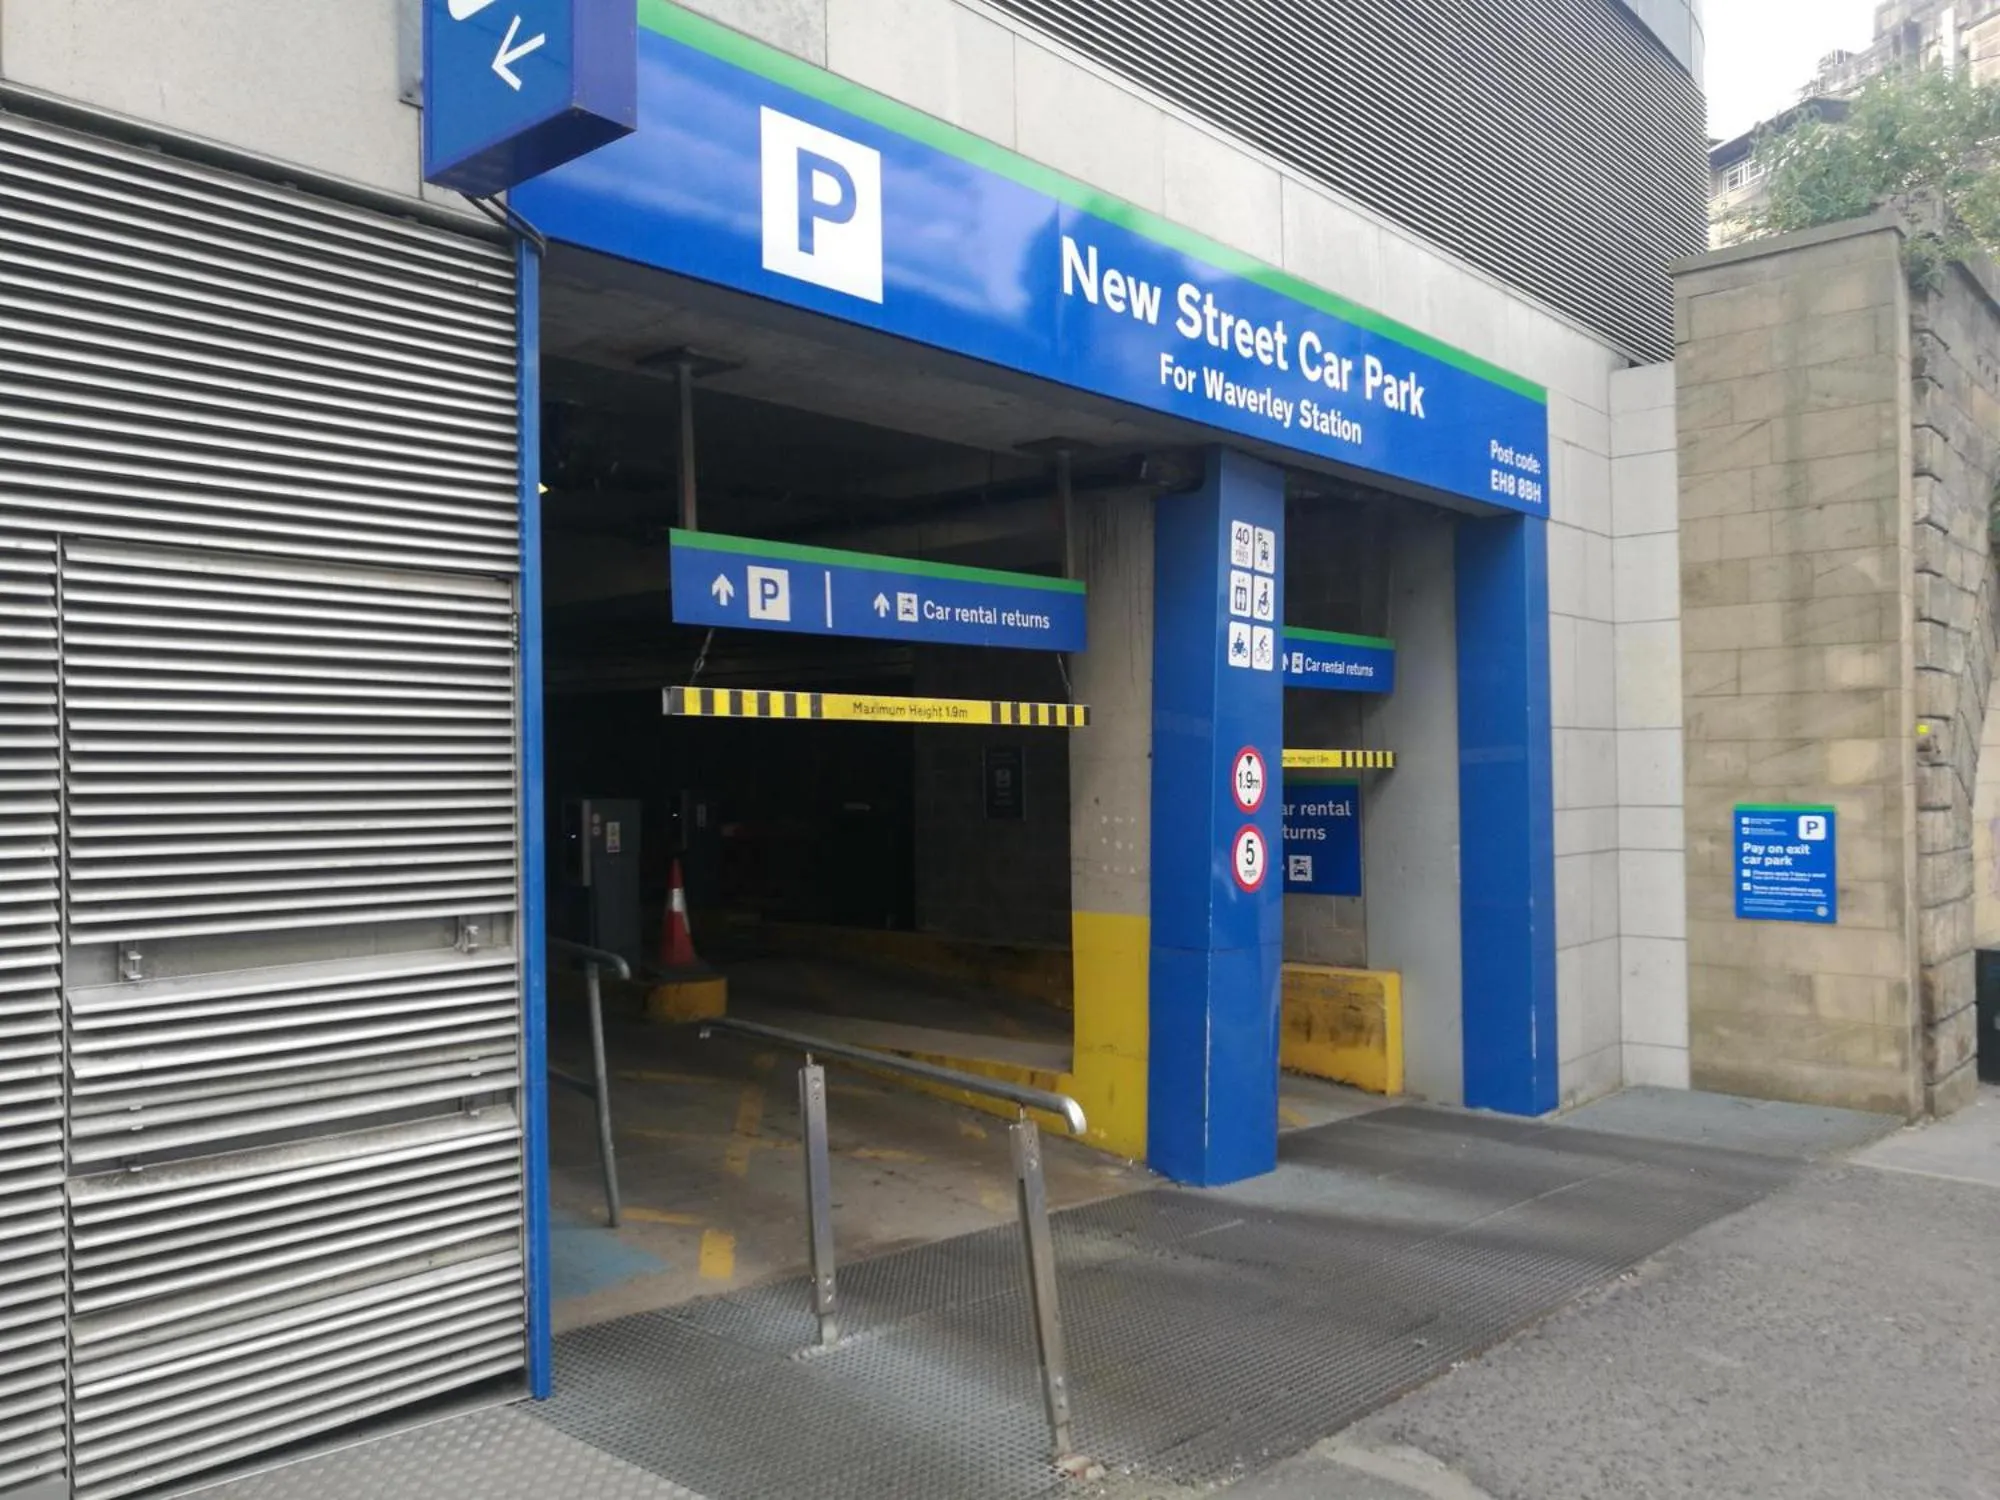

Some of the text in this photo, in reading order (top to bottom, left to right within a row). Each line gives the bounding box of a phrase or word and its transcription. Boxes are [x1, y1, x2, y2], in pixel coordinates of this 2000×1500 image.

[797, 146, 857, 256] P
[1062, 236, 1425, 419] New Street Car Park
[1160, 353, 1362, 444] For Waverley Station
[1490, 439, 1541, 474] Post code:
[1491, 469, 1541, 504] EH8 8BH
[1235, 527, 1250, 545] 40
[760, 578, 779, 611] P
[923, 600, 1050, 629] Car rental returns
[1305, 657, 1374, 677] Car rental returns
[853, 701, 906, 716] Maximum
[909, 704, 942, 719] Height
[1238, 771, 1260, 789] 1.9m
[1300, 800, 1352, 816] rental
[1806, 820, 1819, 835] P
[1245, 839, 1255, 866] 5
[1743, 842, 1810, 855] Pay on exit
[1742, 855, 1793, 867] car park
